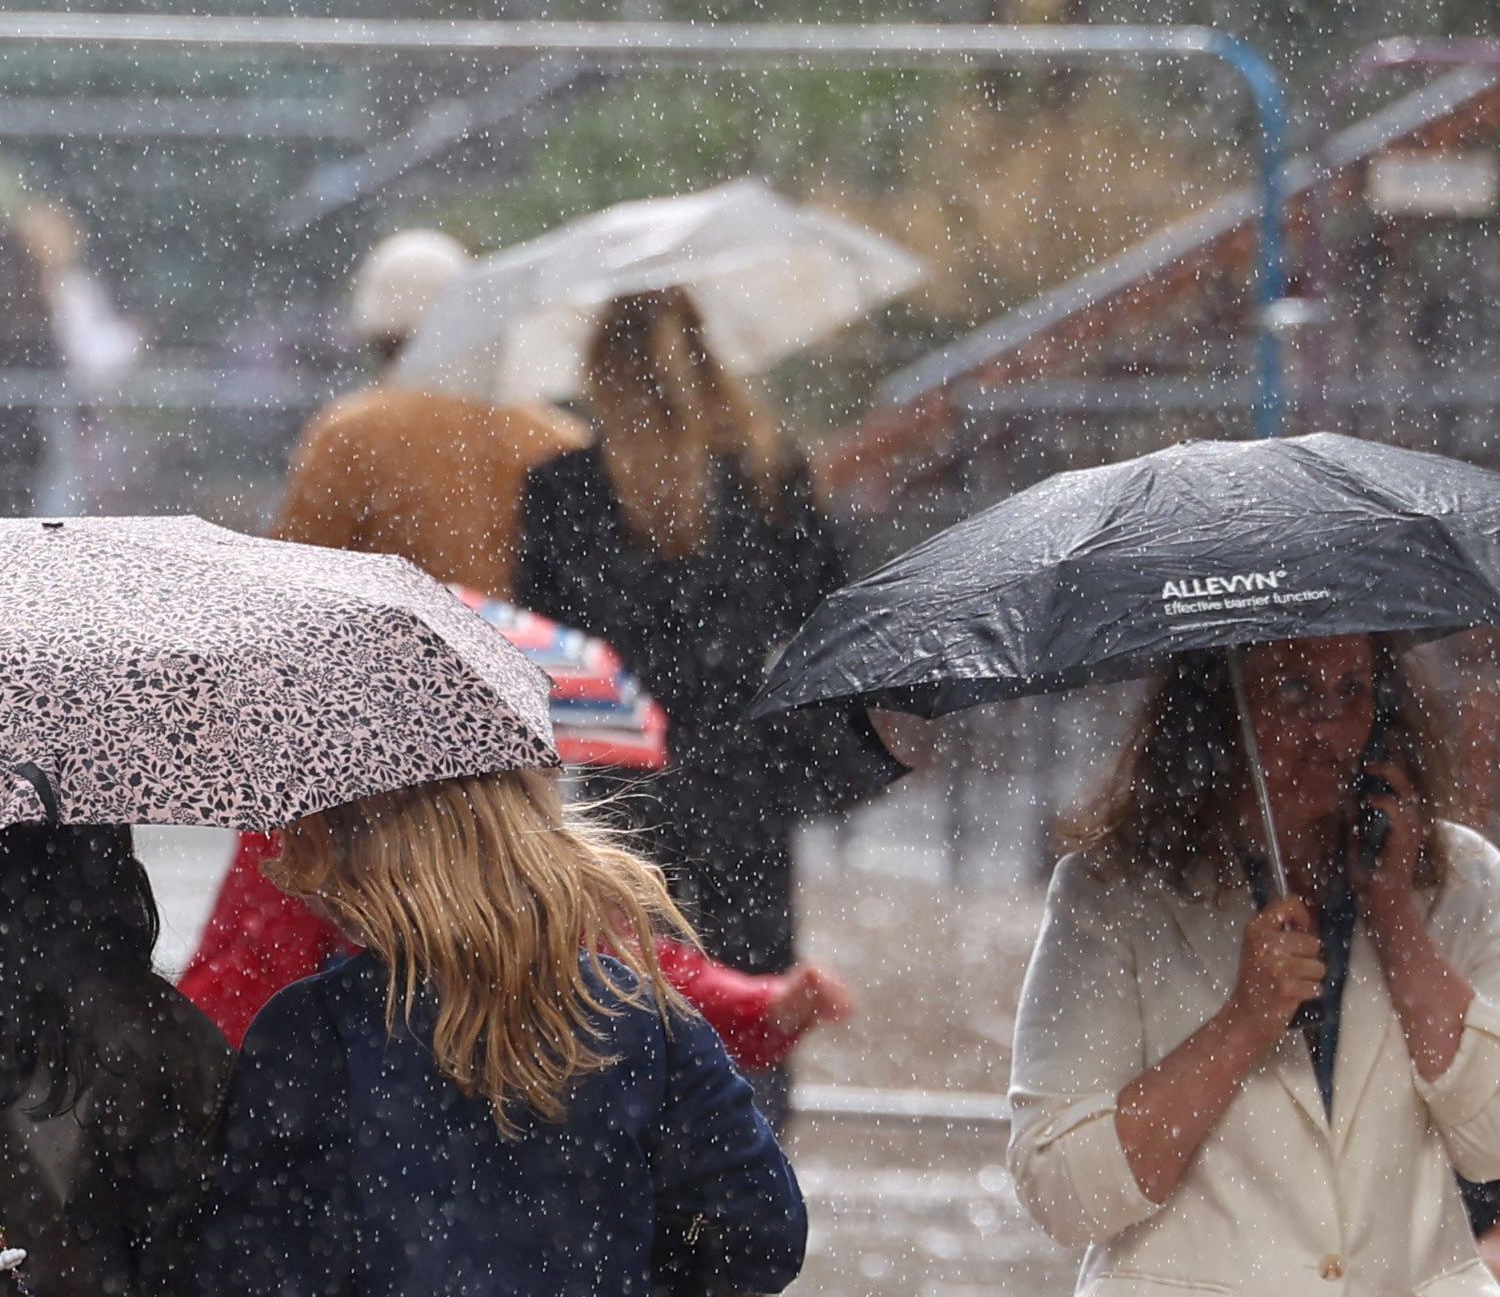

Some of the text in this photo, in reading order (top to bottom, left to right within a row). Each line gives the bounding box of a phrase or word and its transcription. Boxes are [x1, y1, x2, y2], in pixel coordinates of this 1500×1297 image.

[1161, 569, 1279, 600] ALLEVYN
[1163, 588, 1330, 616] Effective barrier function
